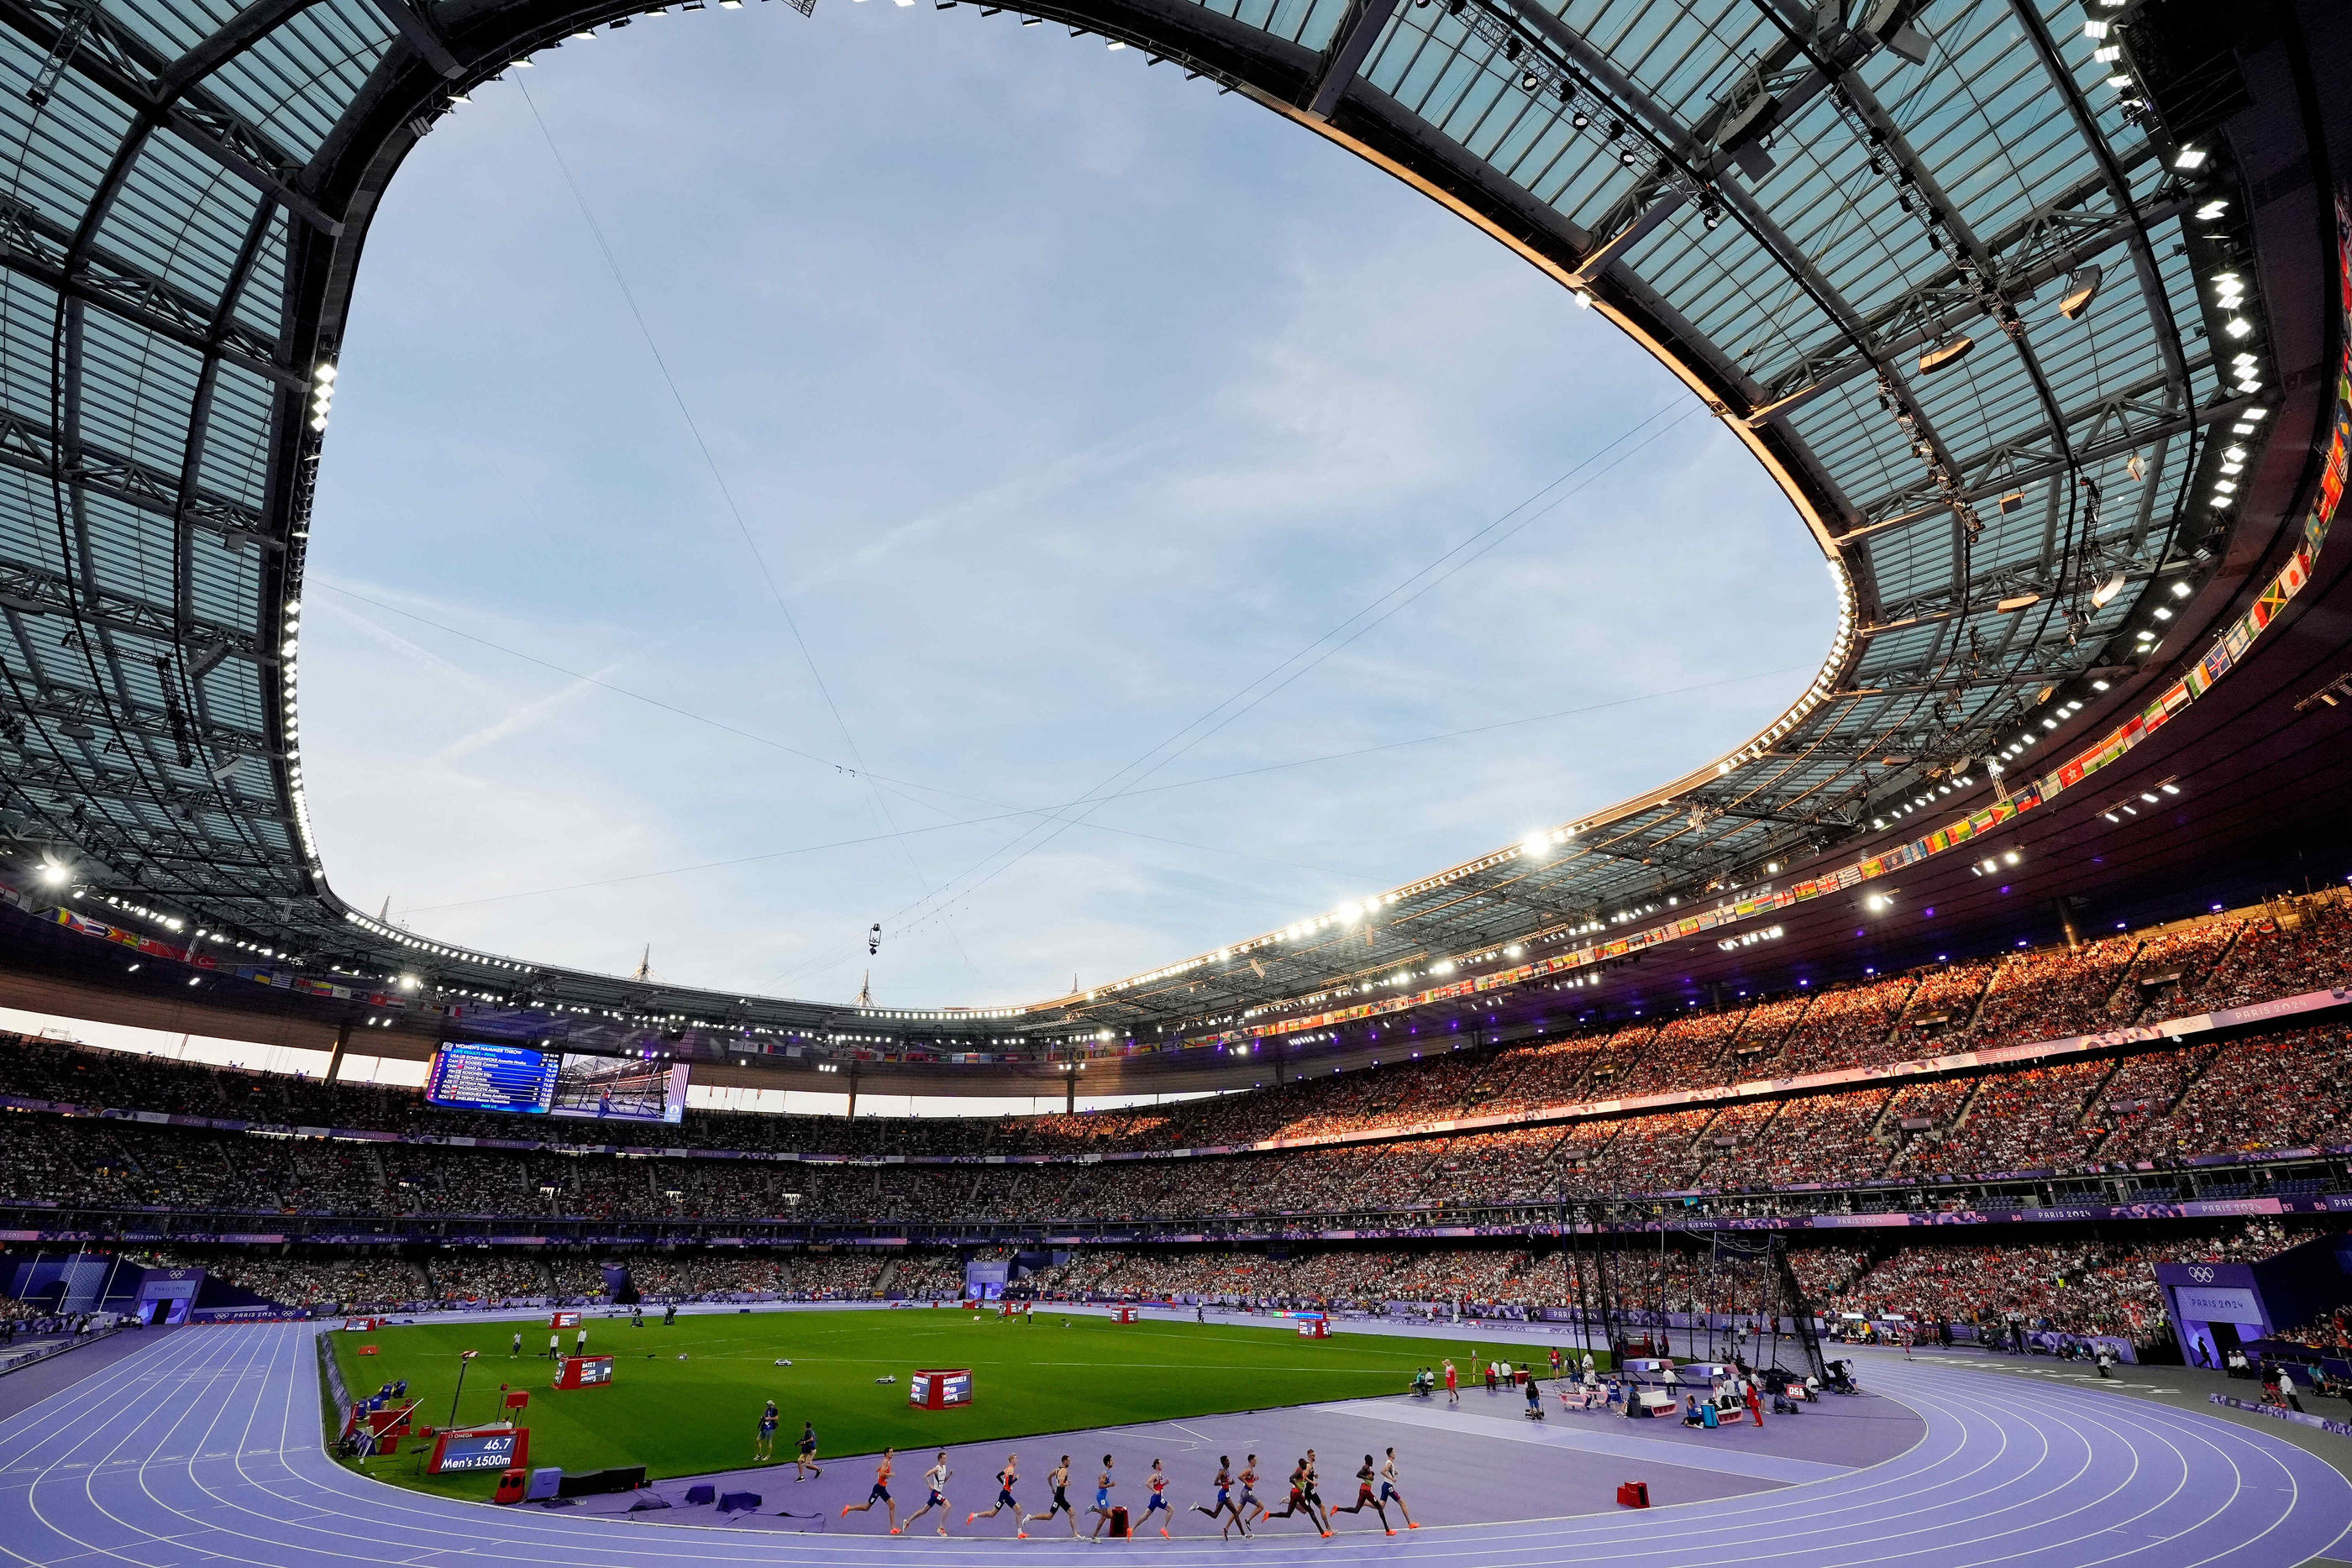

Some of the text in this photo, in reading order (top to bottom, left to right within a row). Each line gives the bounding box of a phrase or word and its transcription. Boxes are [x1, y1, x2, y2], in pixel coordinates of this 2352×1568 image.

[2234, 1000, 2307, 1020] PARIS 2024
[1995, 1045, 2055, 1058] PARIS 2024
[2234, 1203, 2262, 1211] 2024
[2192, 1298, 2244, 1309] PARIS 2024
[484, 1437, 512, 1450] 46.7
[440, 1455, 511, 1469] Men's 1500m
